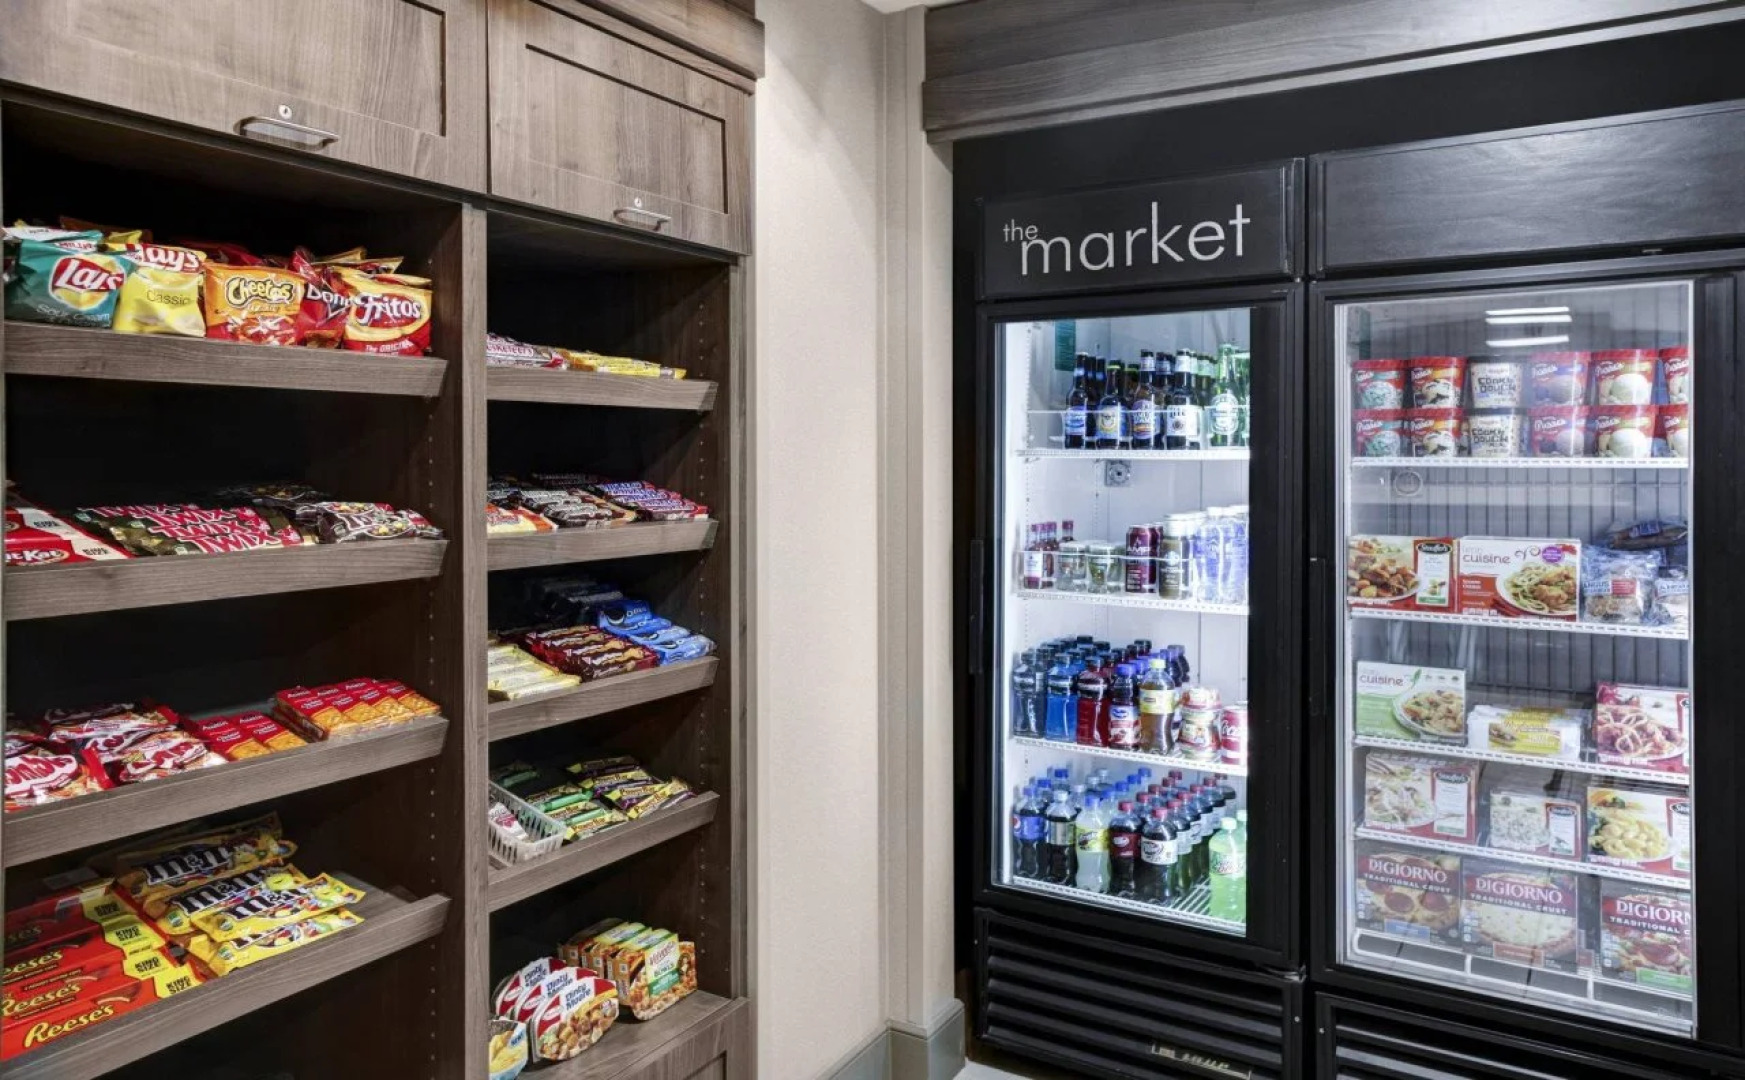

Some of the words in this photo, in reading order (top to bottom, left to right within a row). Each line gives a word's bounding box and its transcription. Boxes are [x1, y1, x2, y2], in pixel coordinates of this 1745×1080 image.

[1003, 219, 1038, 242] the
[1021, 201, 1250, 276] market
[227, 277, 293, 308] Cheetos
[356, 292, 422, 327] Fritos
[177, 532, 283, 554] TWIX
[1462, 554, 1511, 564] cuisine
[1359, 674, 1404, 687] cuisine
[1369, 859, 1448, 883] DIGIORNO
[1364, 873, 1420, 889] TRADITIONAL
[1475, 877, 1562, 904] DIGIORNO
[1471, 892, 1533, 909] TRADITIONAL
[1609, 916, 1680, 933] TRADITIONAL
[138, 963, 162, 973] SIZE
[169, 981, 192, 994] SIZE
[24, 1005, 115, 1048] Reese's
